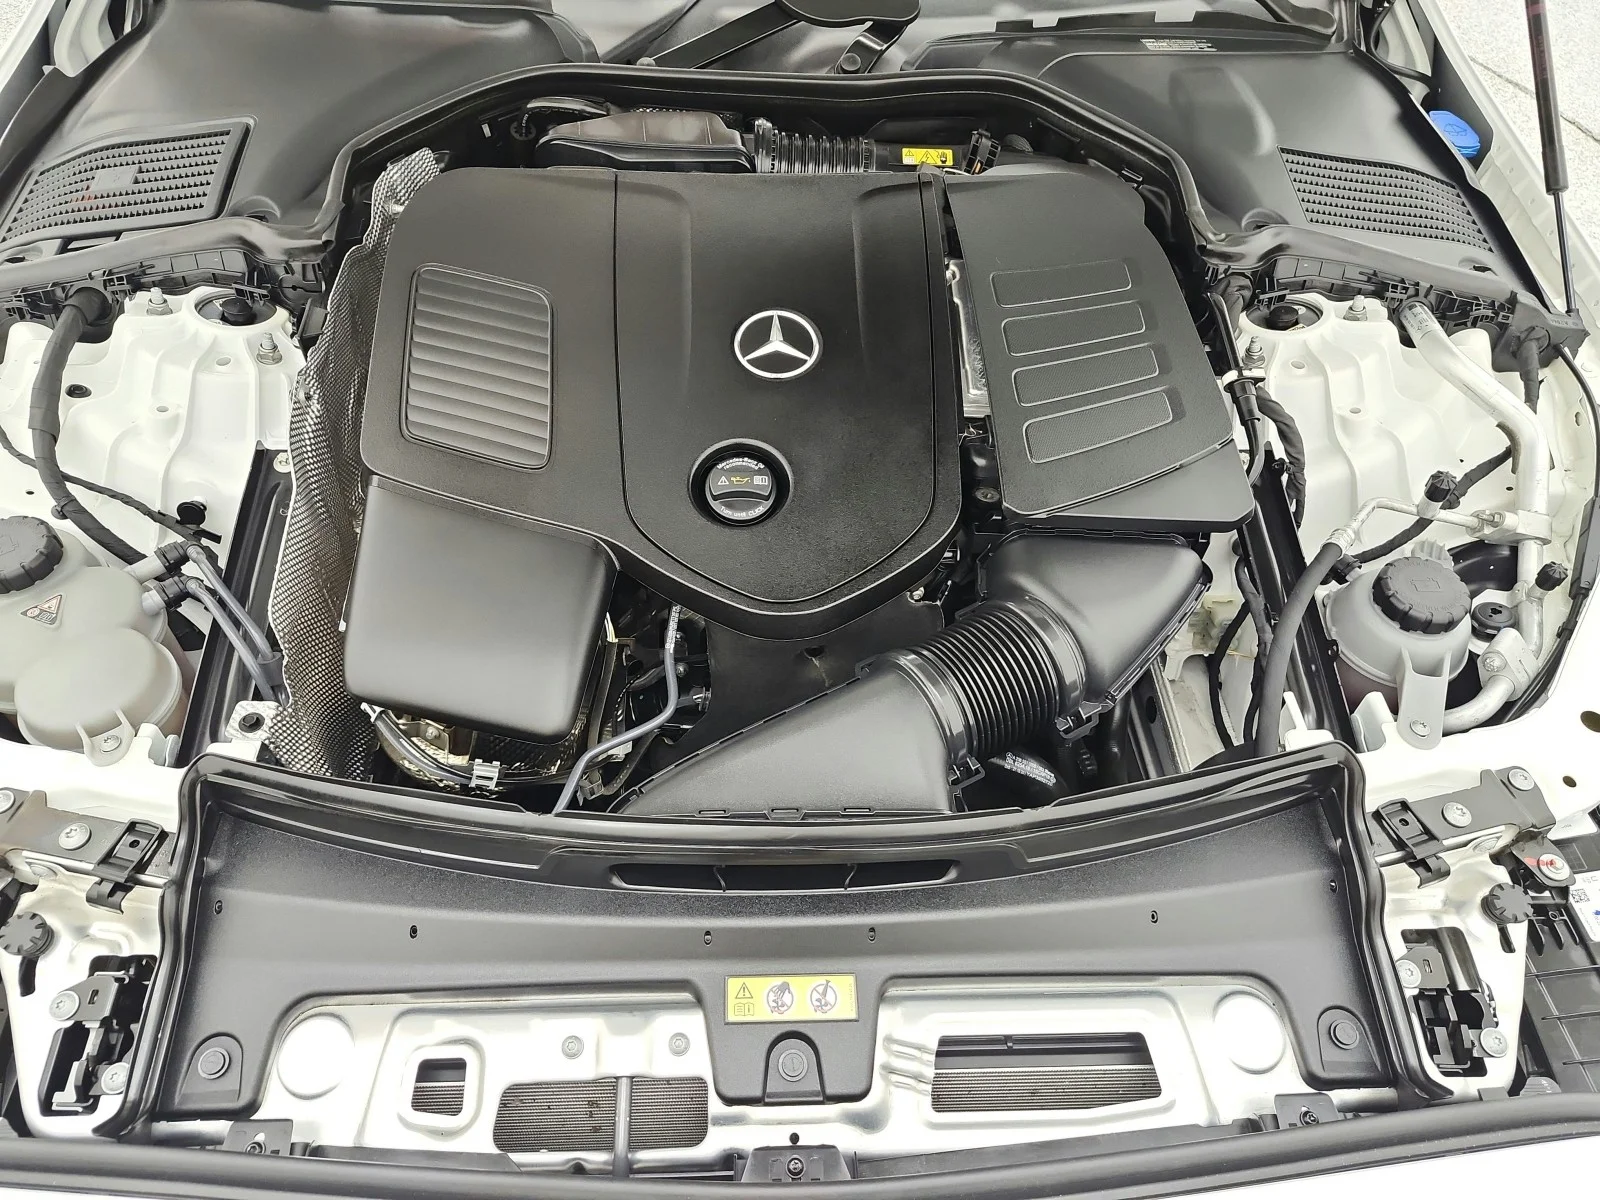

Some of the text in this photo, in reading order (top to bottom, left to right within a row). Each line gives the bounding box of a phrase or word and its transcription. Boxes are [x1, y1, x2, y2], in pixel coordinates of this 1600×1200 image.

[716, 457, 758, 469] Mercedes-Benz
[723, 461, 759, 470] recommended
[720, 505, 732, 515] Turn
[748, 505, 765, 516] CLICK
